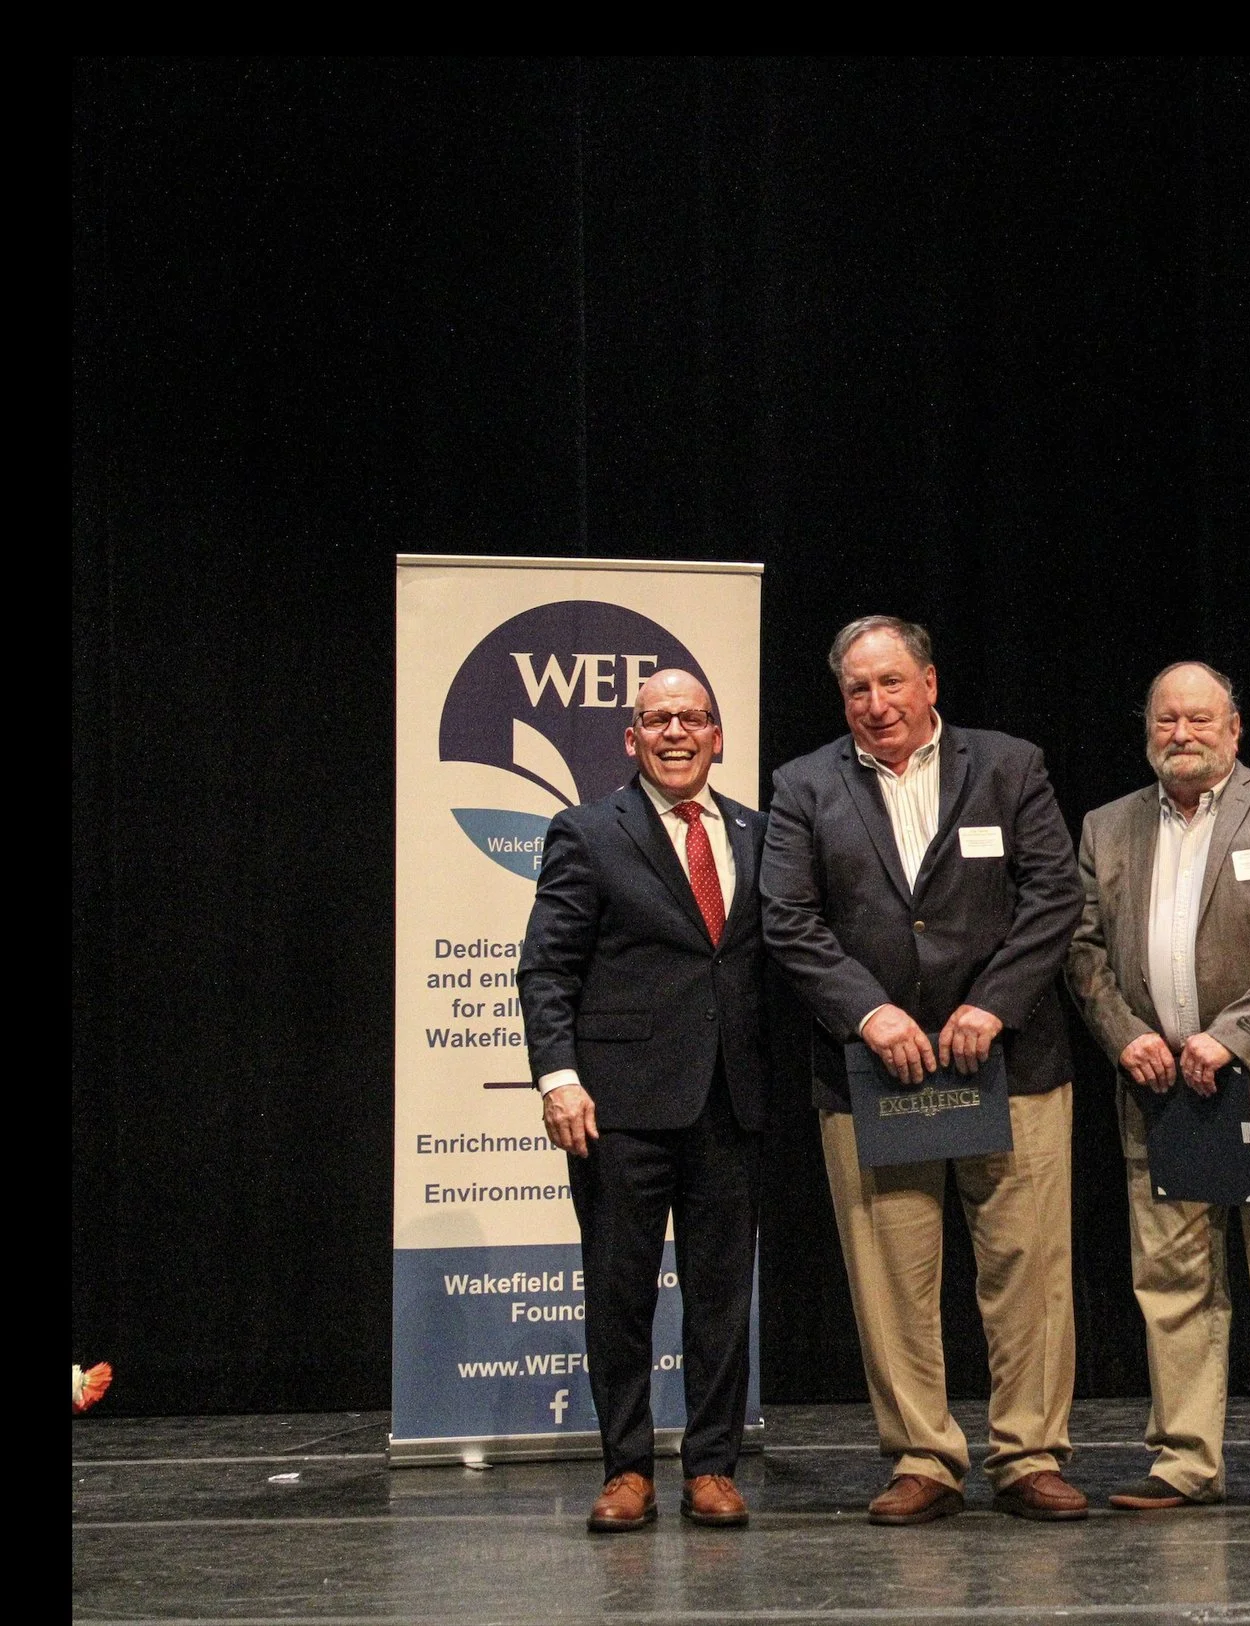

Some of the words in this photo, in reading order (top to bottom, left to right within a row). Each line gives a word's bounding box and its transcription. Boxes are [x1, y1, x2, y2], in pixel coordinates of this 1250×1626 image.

[509, 652, 659, 708] WEF
[426, 969, 472, 989] and
[451, 998, 486, 1018] for
[493, 997, 520, 1017] all
[879, 1090, 979, 1113] EXCELLENCE
[425, 1182, 571, 1203] Environmen
[443, 1271, 564, 1296] Wakefield
[511, 1301, 586, 1323] Found
